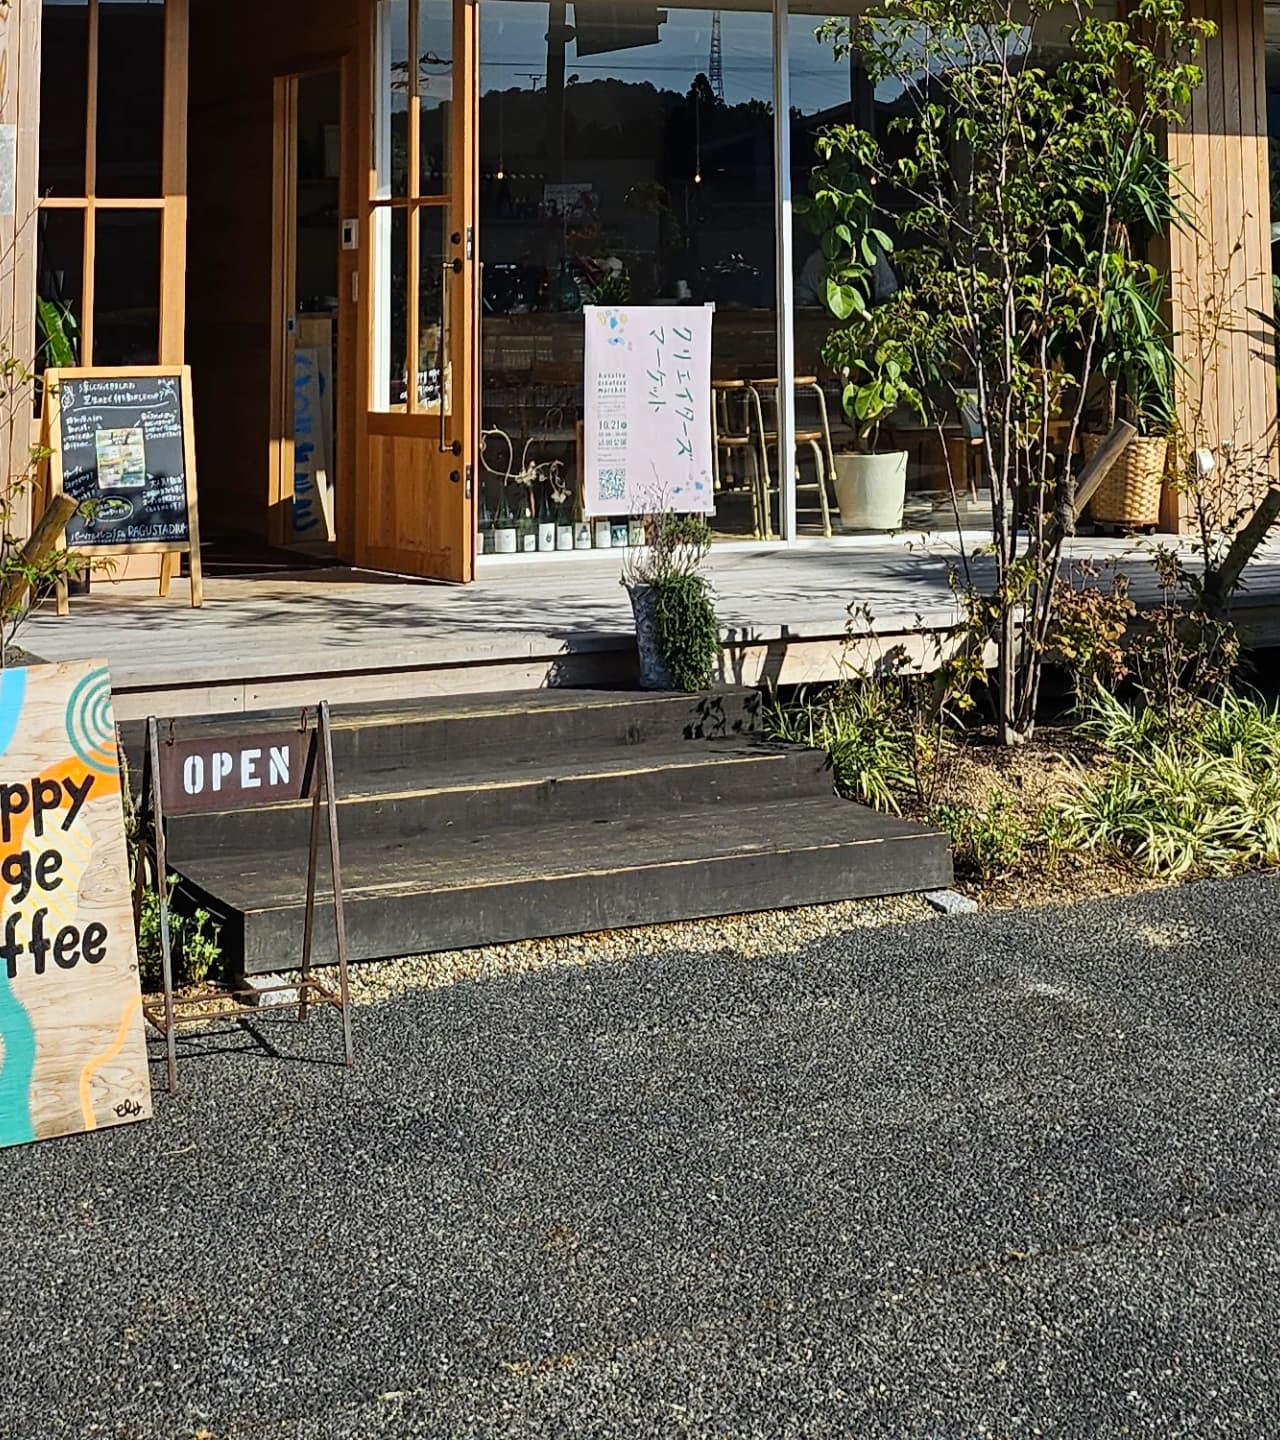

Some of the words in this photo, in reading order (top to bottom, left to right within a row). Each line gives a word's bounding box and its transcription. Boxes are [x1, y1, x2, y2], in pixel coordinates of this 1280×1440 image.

[647, 326, 666, 413] マーケット
[673, 327, 694, 461] クリエイターズ
[183, 745, 290, 795] OPEN
